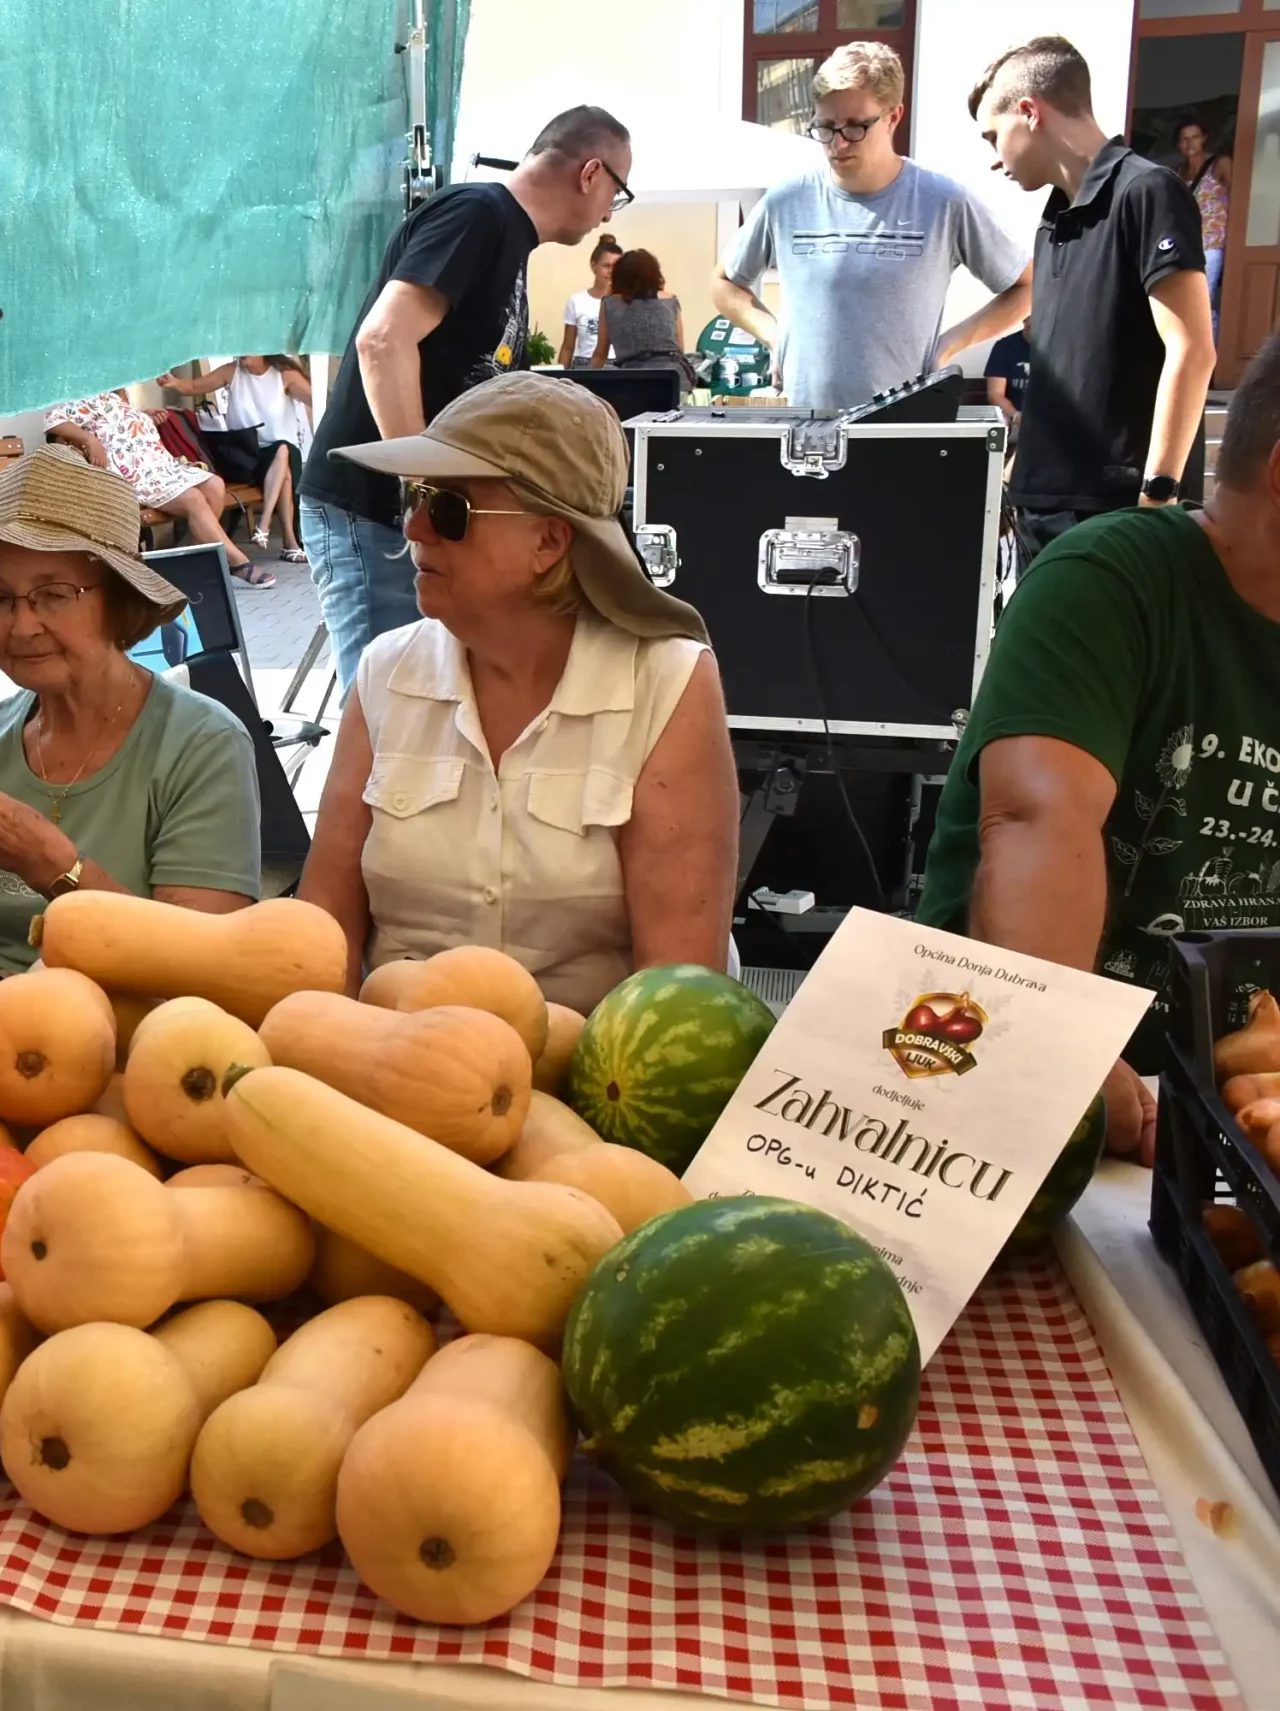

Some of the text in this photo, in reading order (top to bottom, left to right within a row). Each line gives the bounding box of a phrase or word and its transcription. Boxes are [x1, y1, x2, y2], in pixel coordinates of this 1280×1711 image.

[1198, 734, 1225, 759] 9.
[1227, 779, 1280, 814] U Č
[1184, 898, 1236, 909] ZDRAVA
[1203, 916, 1268, 927] VAŠ IZBOR
[914, 944, 1047, 992] Općina Donja Dubrava
[895, 1034, 964, 1064] DOBRAVSKI
[906, 1052, 936, 1069] LJUK
[872, 1085, 925, 1111] dodjeljuje
[753, 1068, 1014, 1202] Zahvalnicu
[746, 1134, 928, 1218] OPG-u DIKTIĆ
